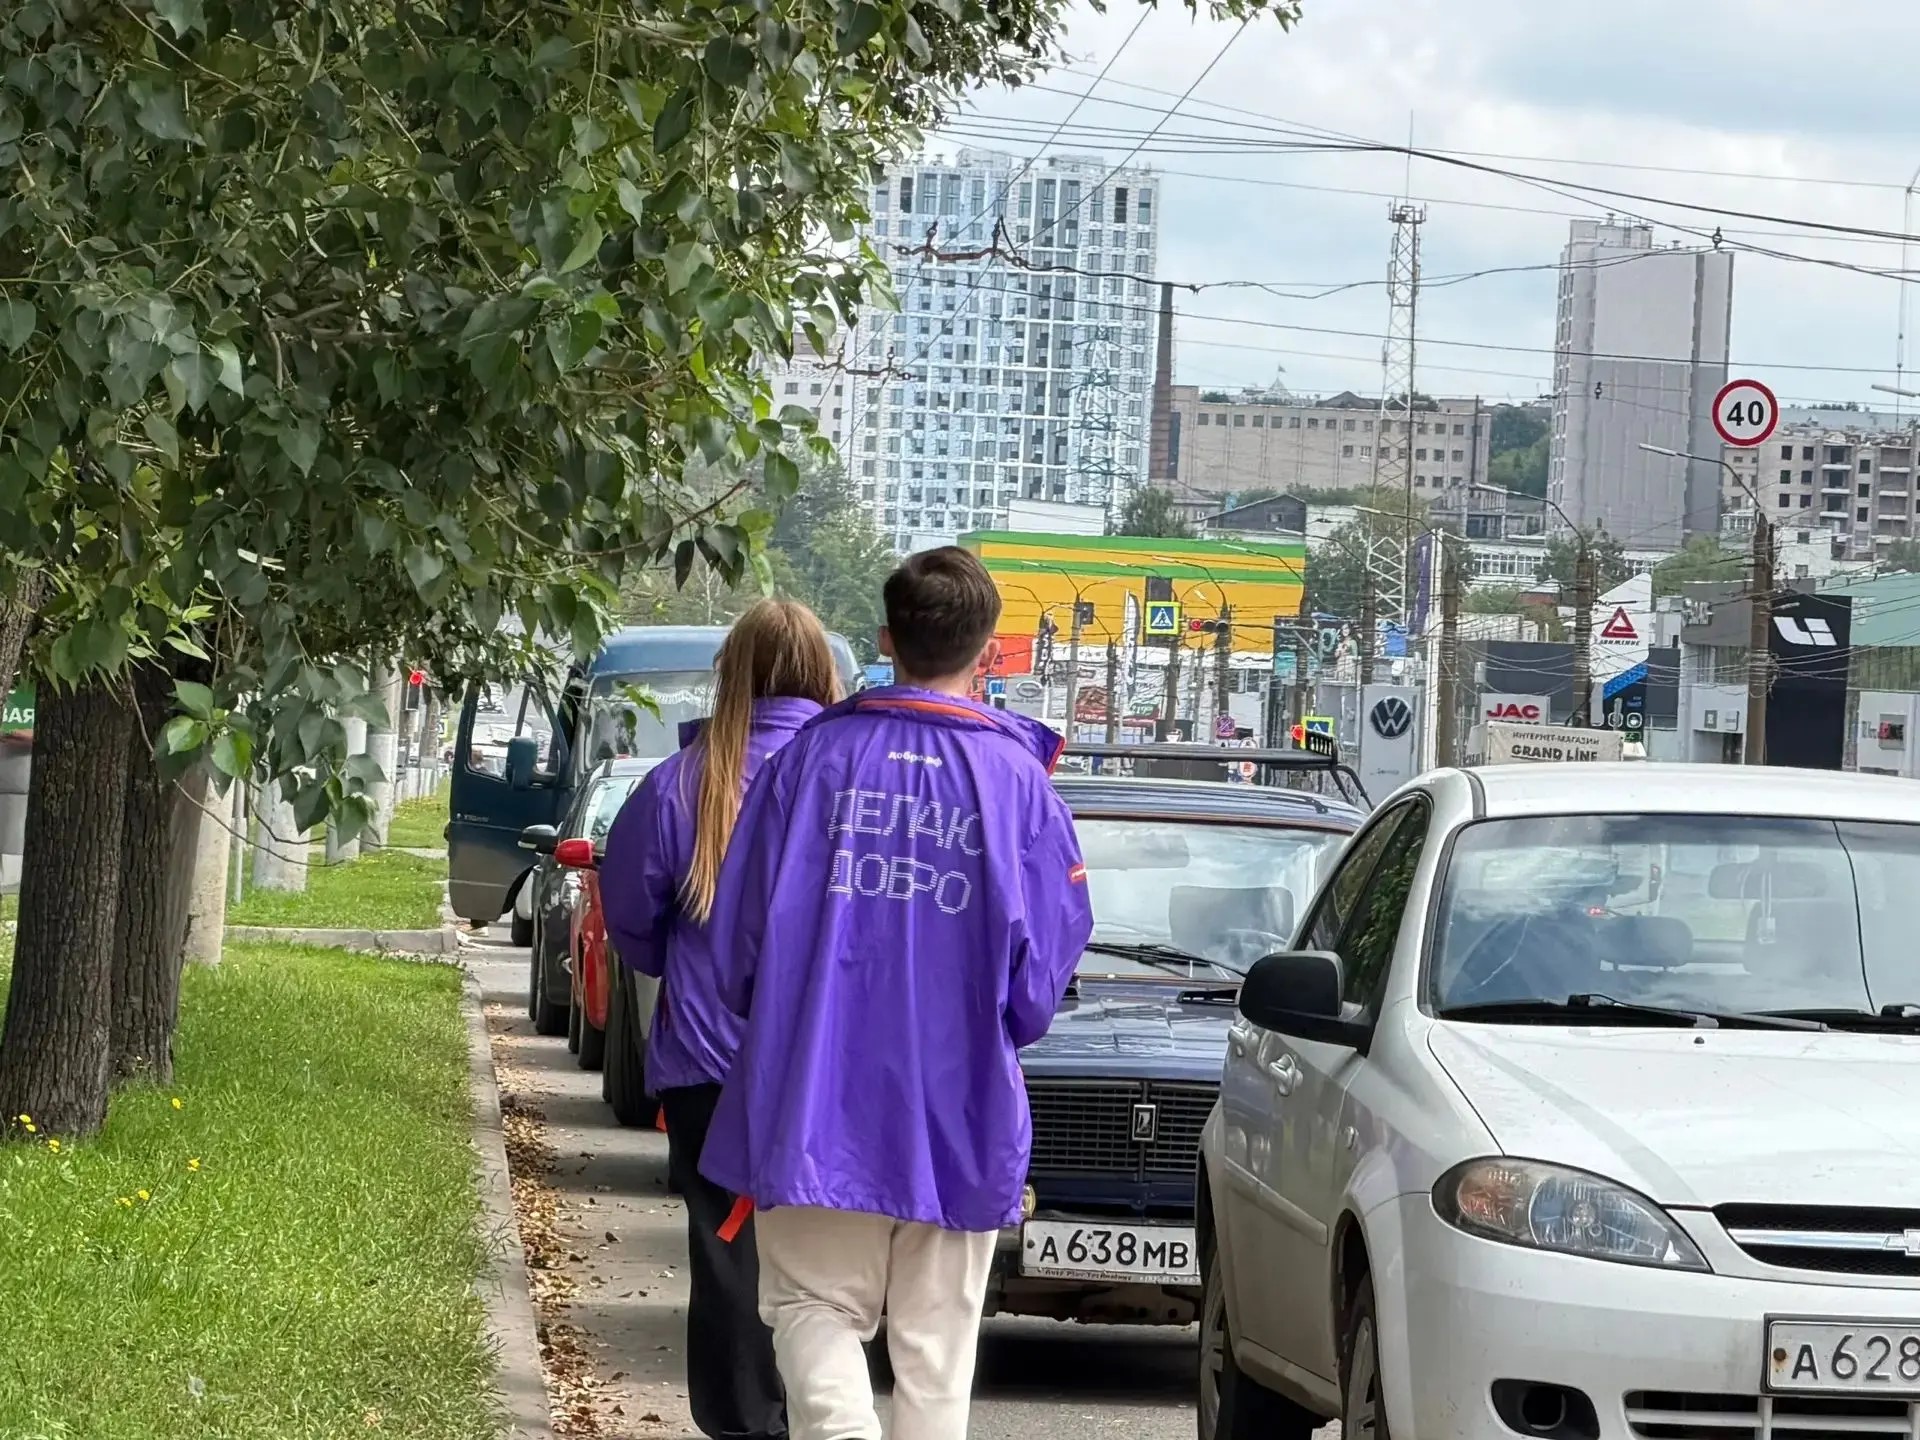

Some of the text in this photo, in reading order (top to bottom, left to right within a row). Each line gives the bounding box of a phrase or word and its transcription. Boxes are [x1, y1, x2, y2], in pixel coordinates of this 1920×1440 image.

[1726, 400, 1765, 427] 40
[1486, 703, 1540, 719] JAC
[1512, 731, 1600, 746] ИНТЕРНЕТ-МАГАЗИН
[1511, 744, 1563, 761] GRAND
[826, 849, 973, 916] ДОБРО
